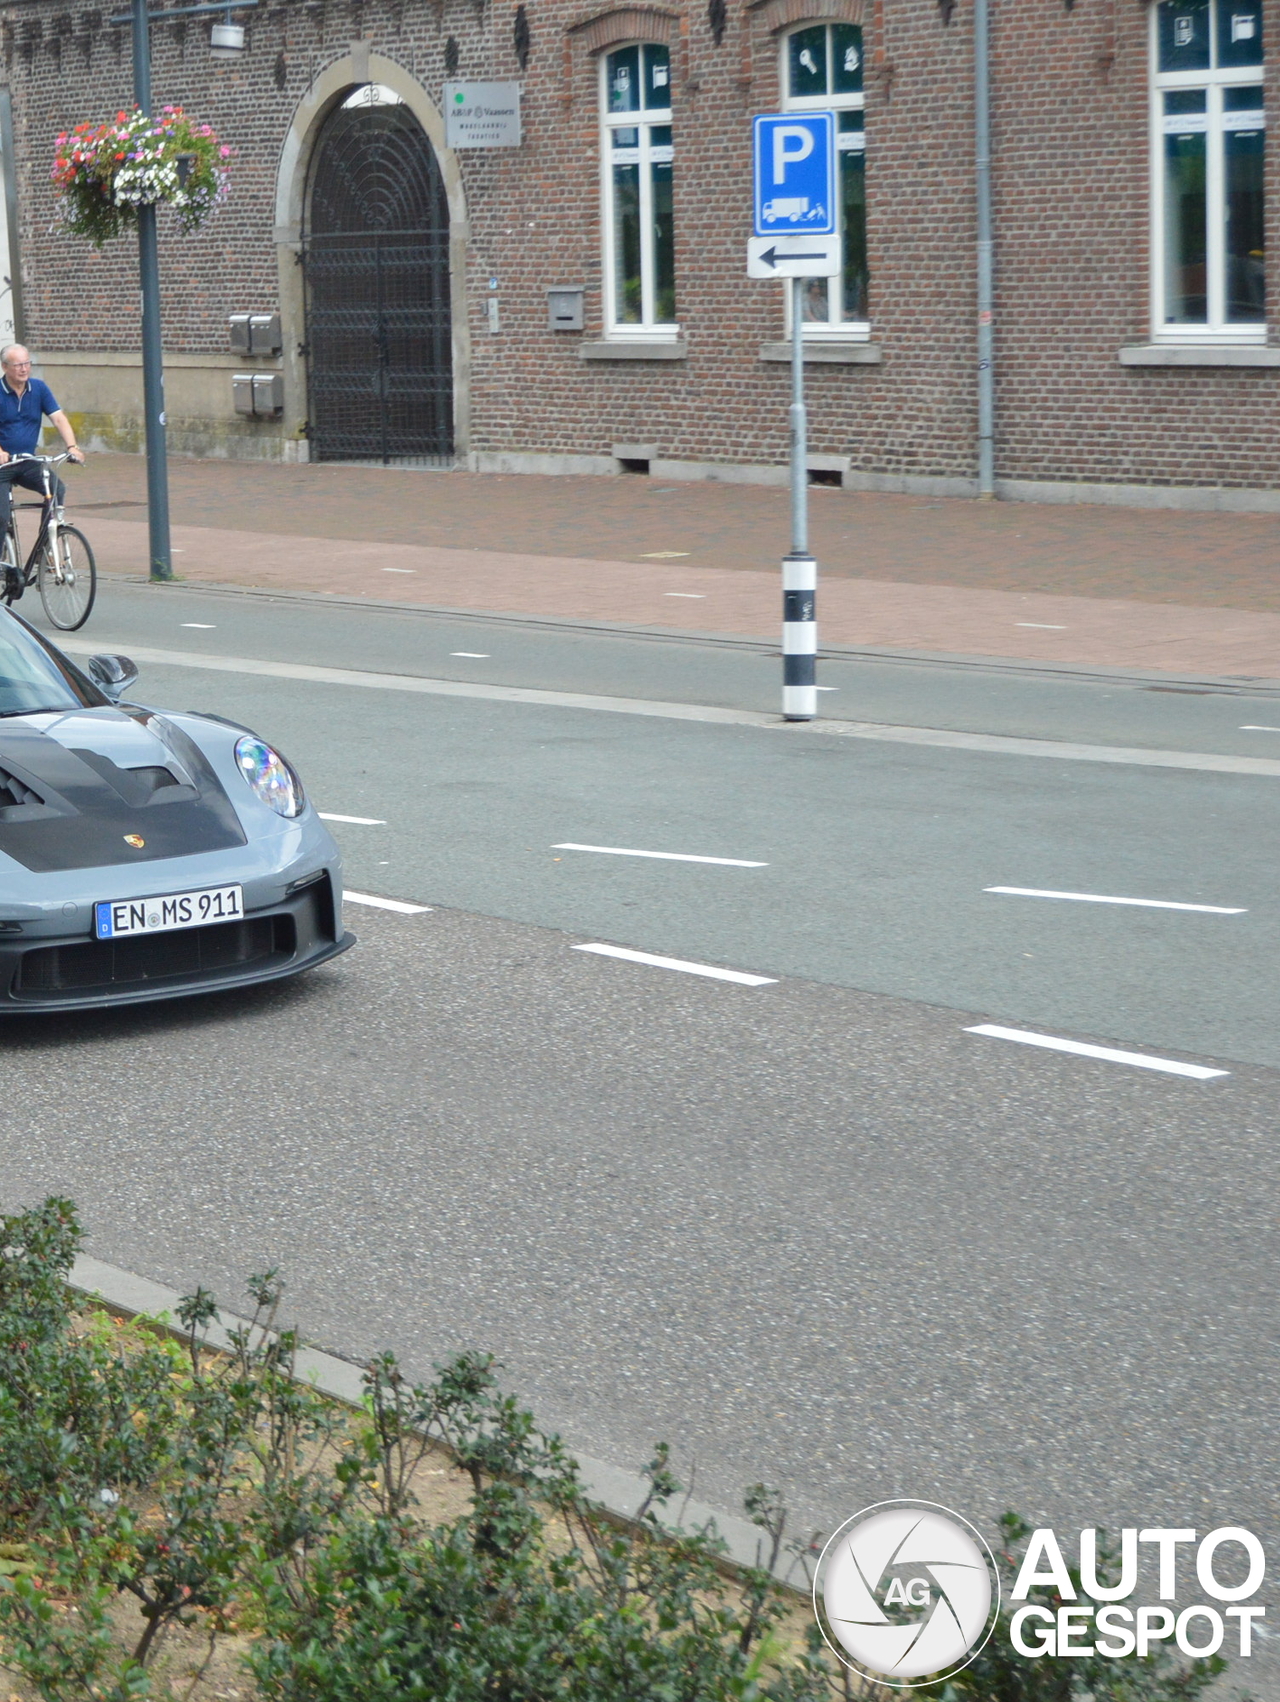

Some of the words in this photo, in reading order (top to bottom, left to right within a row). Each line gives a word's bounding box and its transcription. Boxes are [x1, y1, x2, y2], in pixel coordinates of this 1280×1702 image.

[772, 125, 814, 185] P
[113, 903, 145, 931] EN
[162, 897, 192, 925] MS
[198, 890, 240, 919] 911
